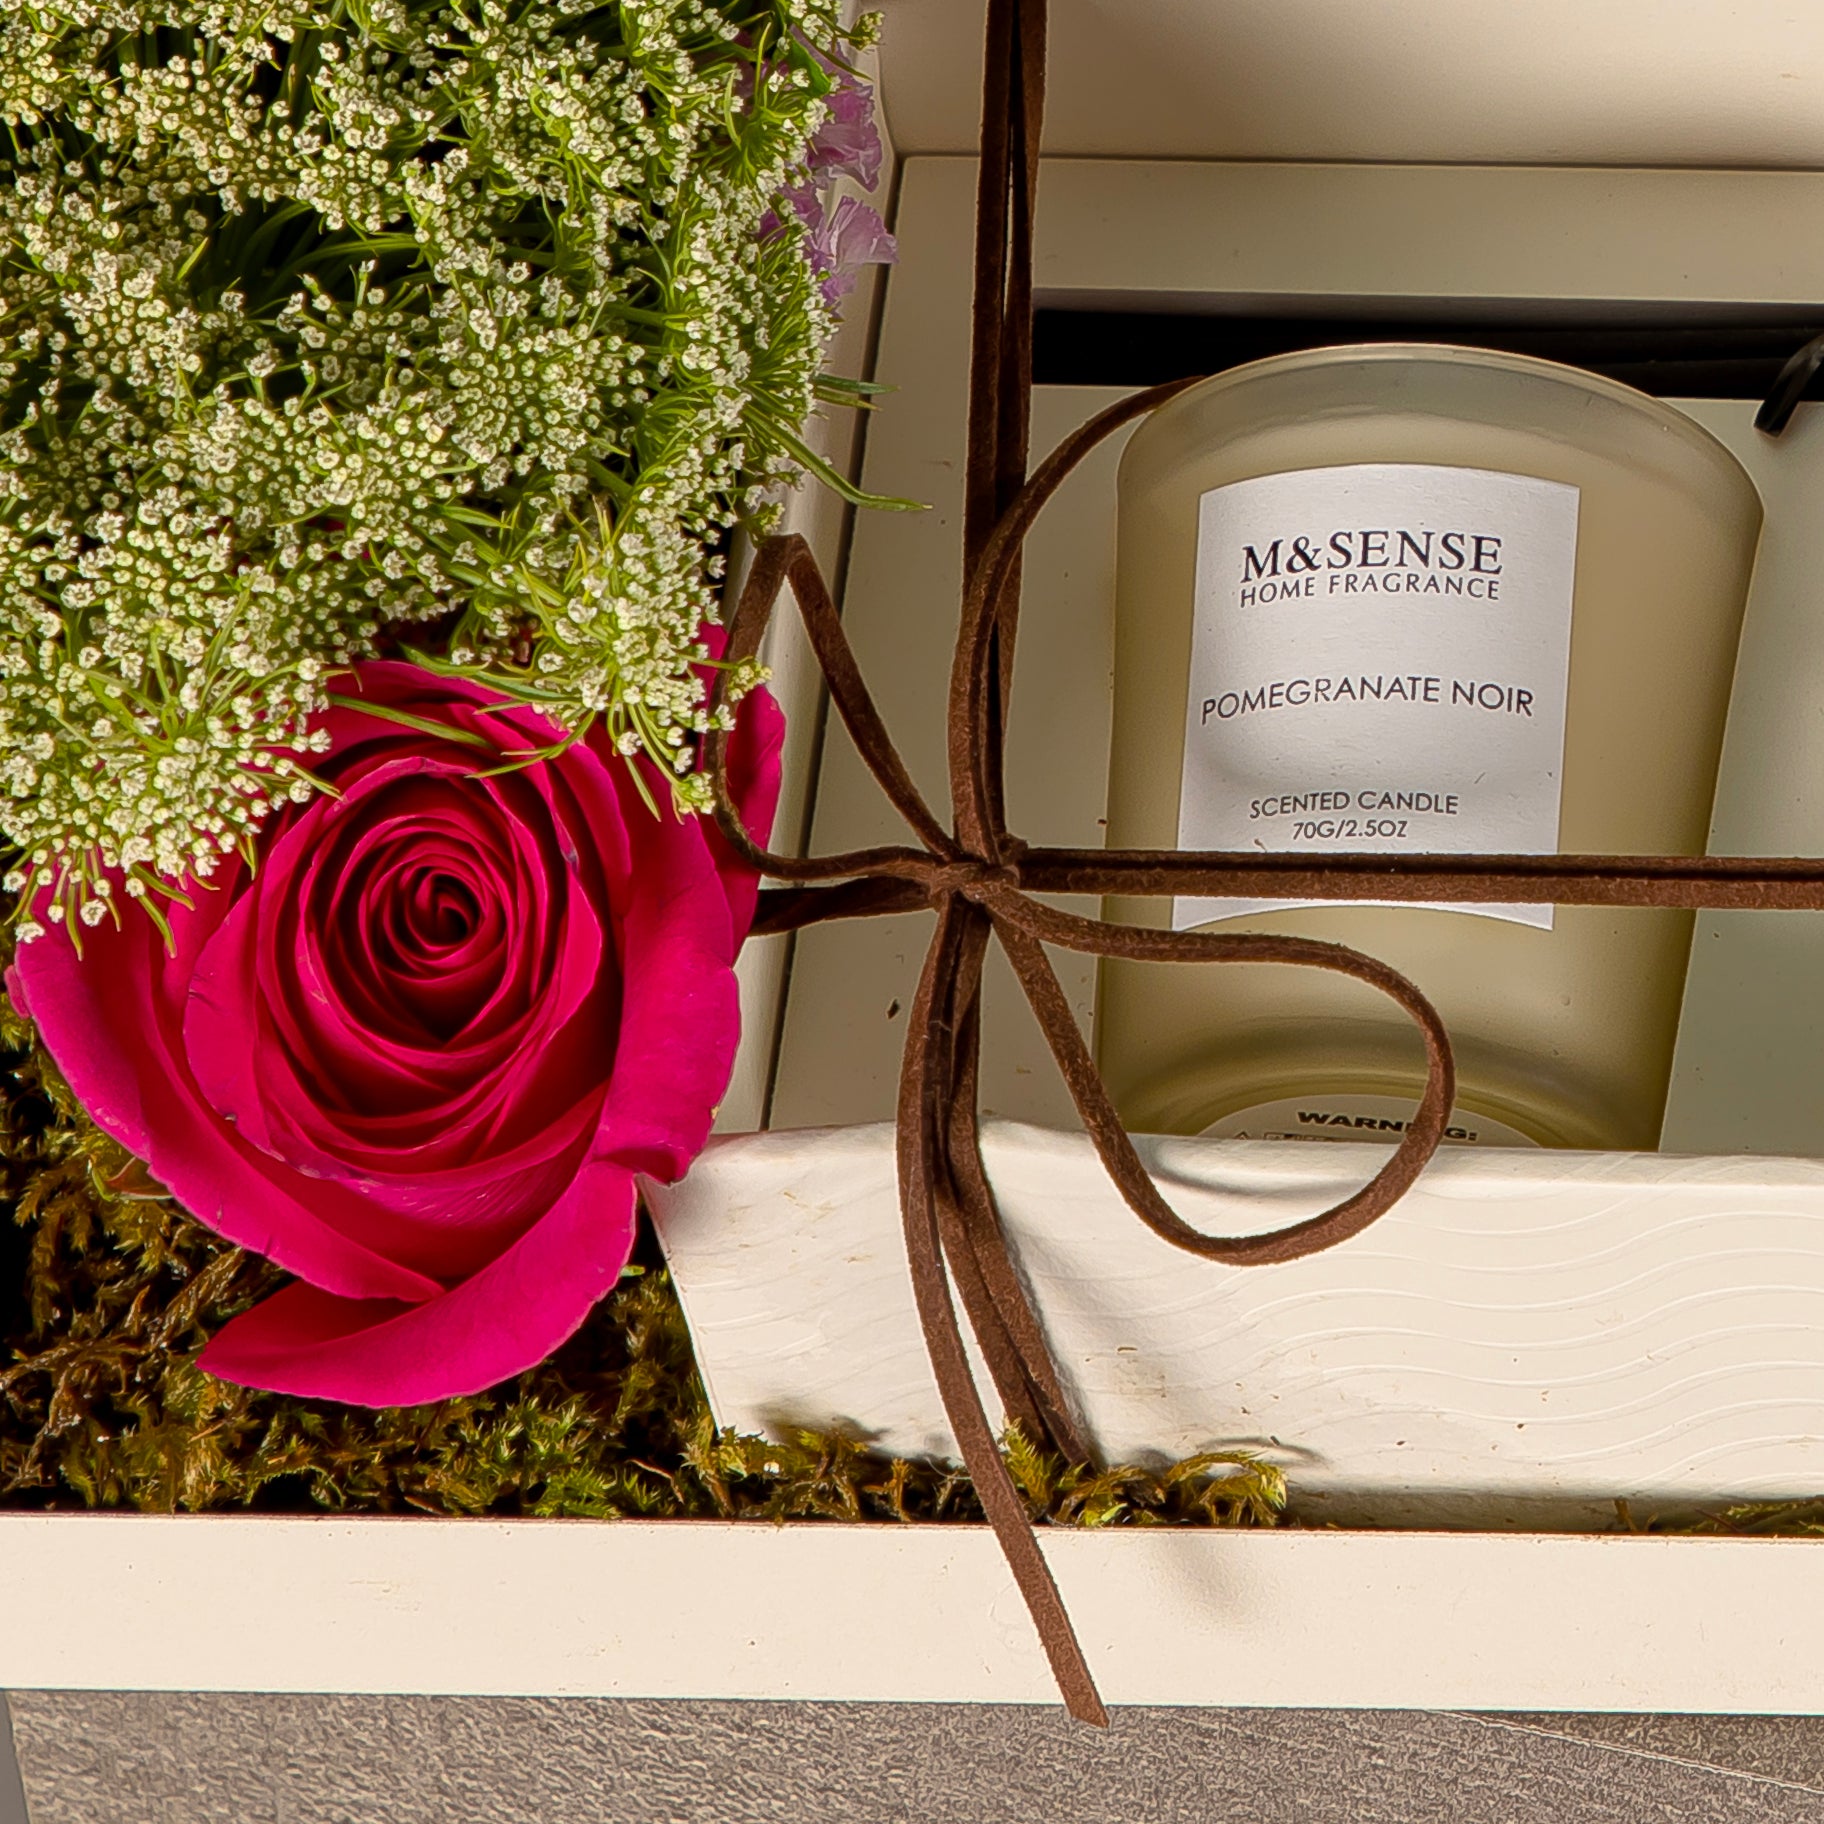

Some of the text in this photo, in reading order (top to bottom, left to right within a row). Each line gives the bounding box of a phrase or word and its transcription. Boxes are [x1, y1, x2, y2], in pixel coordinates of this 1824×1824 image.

[1239, 530, 1504, 584] M&SENSE
[1239, 571, 1501, 608] HOME FRAGRANCE
[1201, 676, 1535, 725] POMEGRANATE NOIR
[1249, 790, 1460, 819] SCENTED CANDLE
[1291, 819, 1409, 841] 70G/2.5OZ
